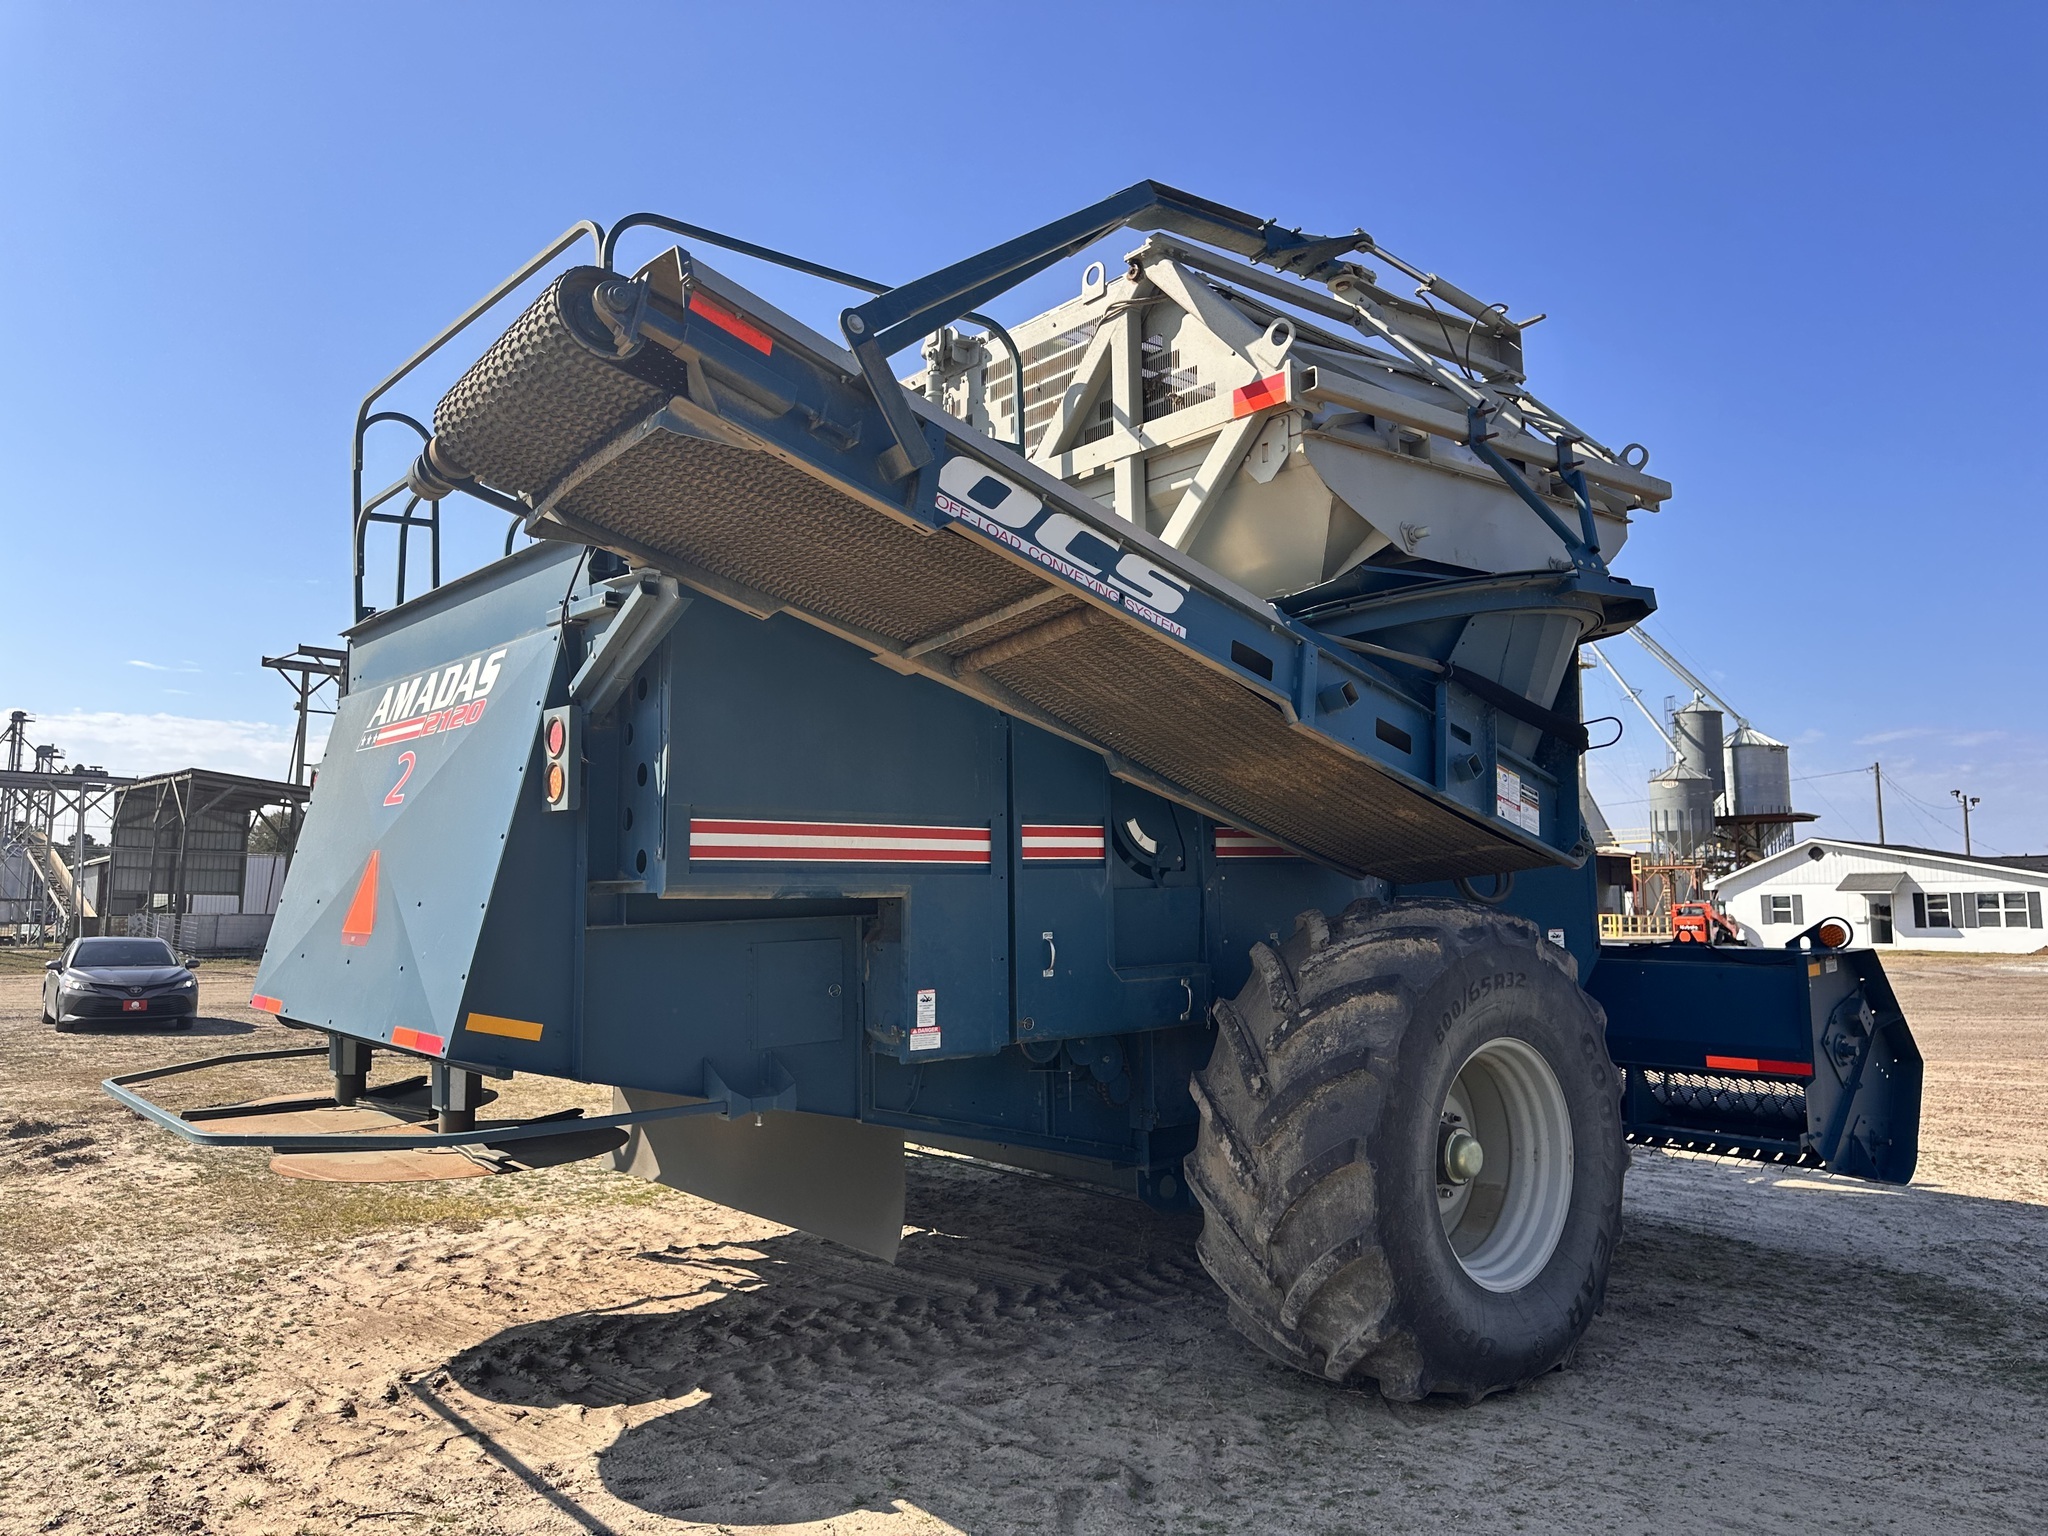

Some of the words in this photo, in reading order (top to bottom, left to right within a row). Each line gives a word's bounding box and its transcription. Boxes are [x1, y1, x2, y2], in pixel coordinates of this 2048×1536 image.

[935, 494, 1022, 551] OFF-LOAD
[1028, 545, 1120, 603] CONVEYING
[1123, 598, 1183, 637] SYSTEM
[938, 455, 1190, 613] OCS
[367, 649, 507, 728] AMADAS
[420, 698, 487, 738] 2120
[383, 750, 417, 806] 2
